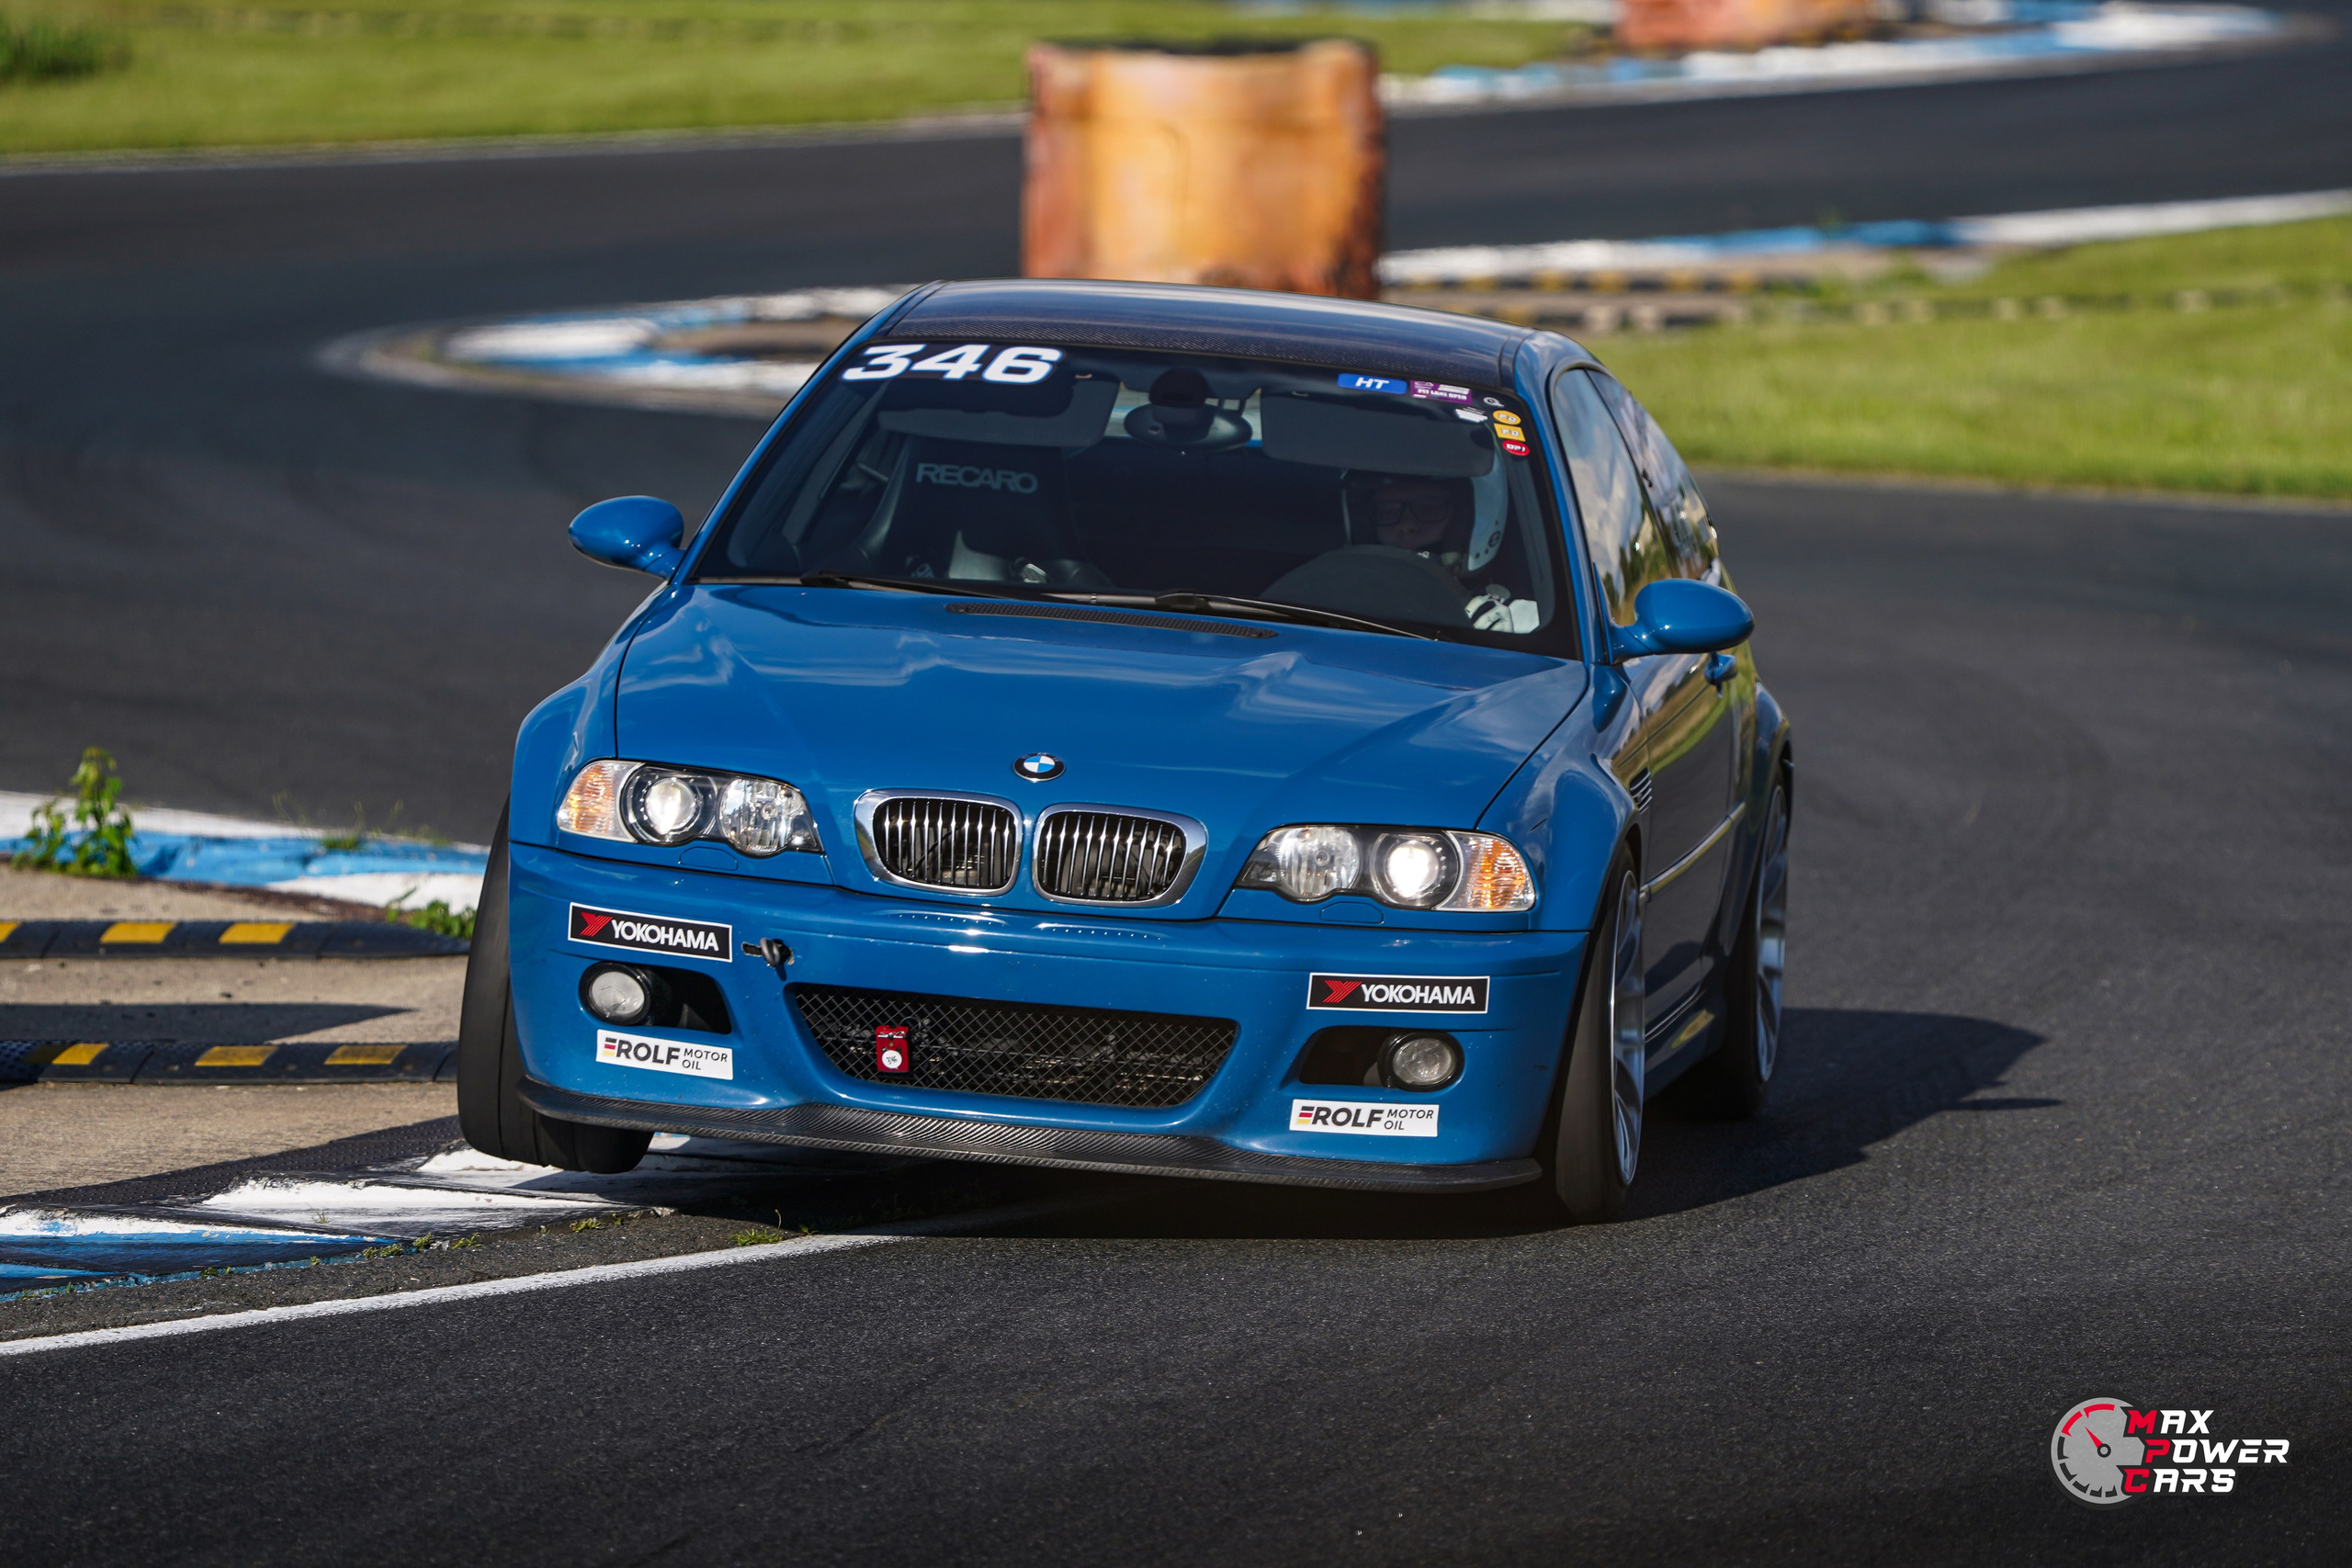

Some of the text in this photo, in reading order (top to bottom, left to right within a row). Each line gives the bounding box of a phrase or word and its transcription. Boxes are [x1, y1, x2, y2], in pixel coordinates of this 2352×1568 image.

[842, 344, 1063, 384] 346
[1355, 377, 1390, 389] HT
[916, 463, 1038, 493] RECARO
[611, 919, 719, 952] YOKOHAMA
[1361, 984, 1476, 1004] YOKOHAMA
[616, 1039, 682, 1066] ROLF
[684, 1048, 728, 1063] MOTOR
[682, 1058, 702, 1070] OIL
[1312, 1106, 1385, 1128] ROLF
[1386, 1109, 1434, 1120] MOTOR
[1384, 1120, 1405, 1131] OIL
